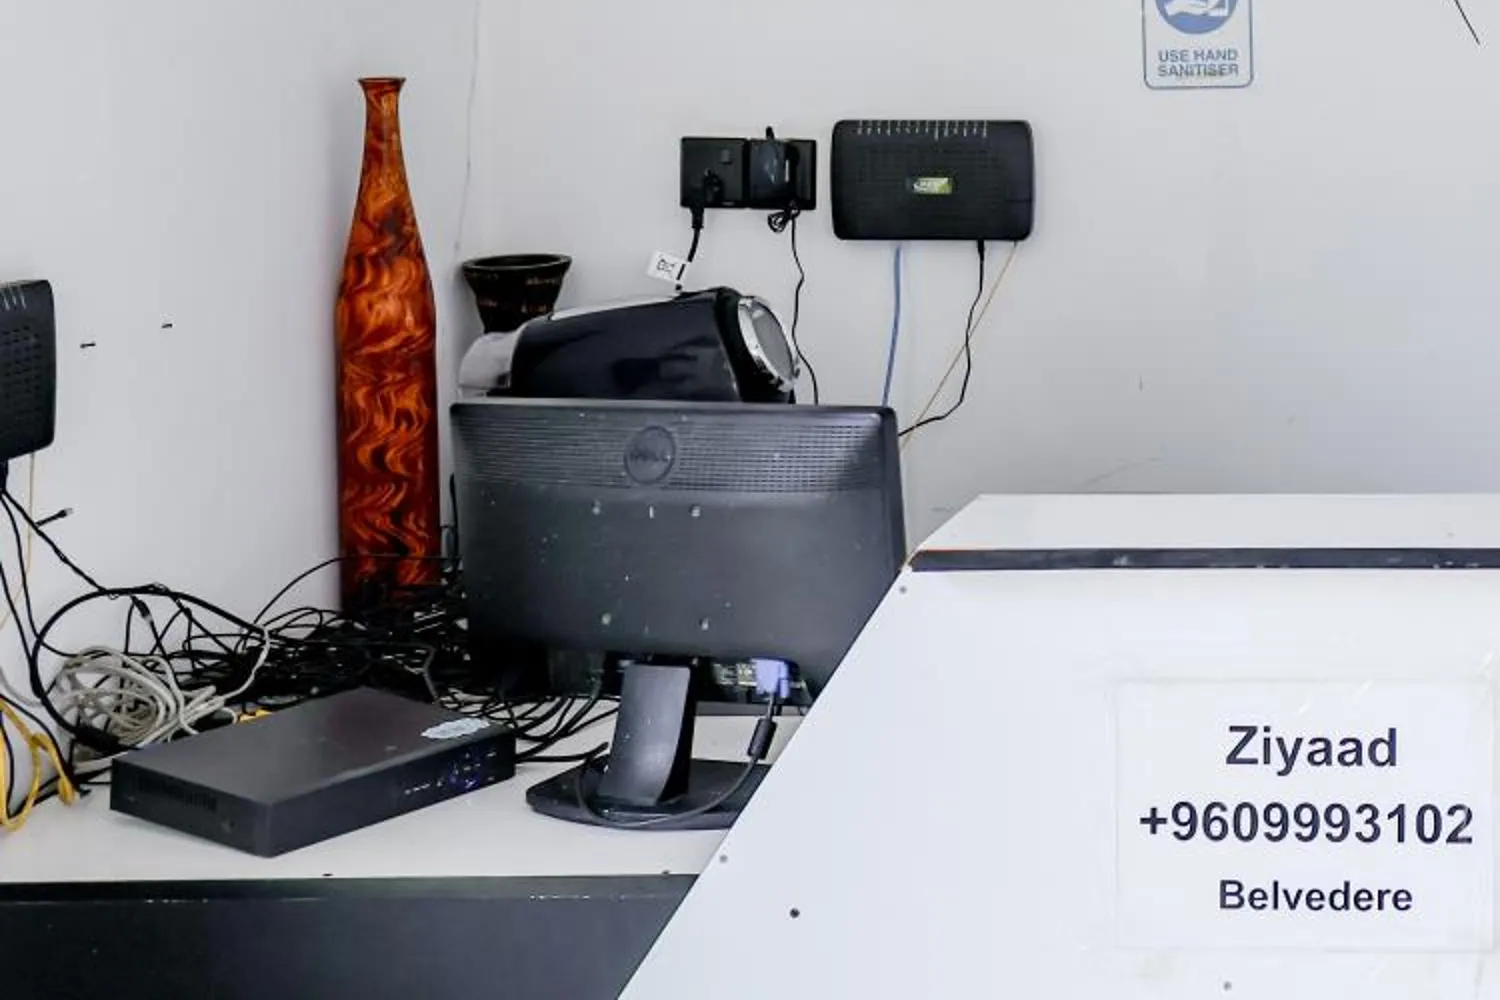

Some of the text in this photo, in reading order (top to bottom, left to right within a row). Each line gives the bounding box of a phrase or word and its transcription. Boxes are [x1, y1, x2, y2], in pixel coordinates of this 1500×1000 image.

[1157, 63, 1240, 78] SANITISER
[1158, 48, 1239, 63] USE HAND
[1226, 725, 1397, 776] Ziyaad
[1139, 801, 1473, 844] +9609993102
[1218, 879, 1413, 911] Belvedere
